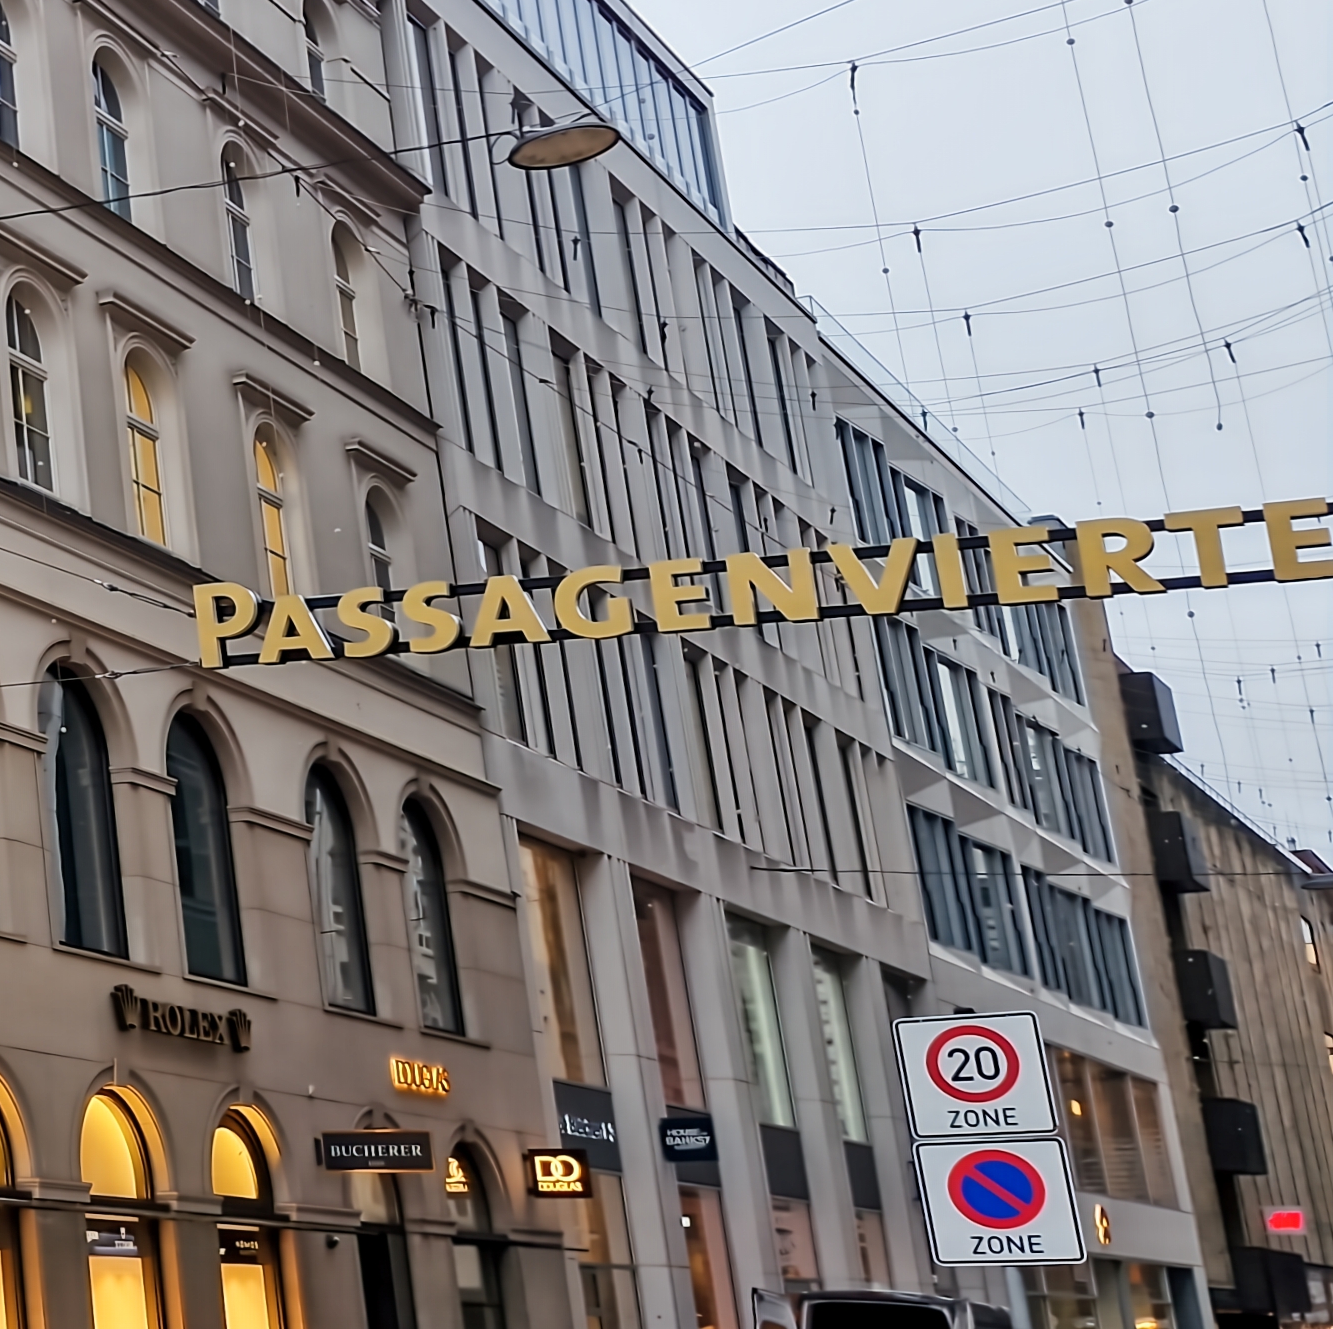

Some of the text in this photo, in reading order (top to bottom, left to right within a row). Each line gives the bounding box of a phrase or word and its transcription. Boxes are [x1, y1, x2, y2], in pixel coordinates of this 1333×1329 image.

[193, 497, 1333, 669] PASSAGENVIERTE
[143, 996, 229, 1046] ROLEX
[947, 1046, 1001, 1082] 20
[947, 1107, 1019, 1129] ZONE
[330, 1144, 423, 1158] BUCHERER
[538, 1181, 583, 1192] DOUGLAS
[970, 1234, 1045, 1255] ZONE
